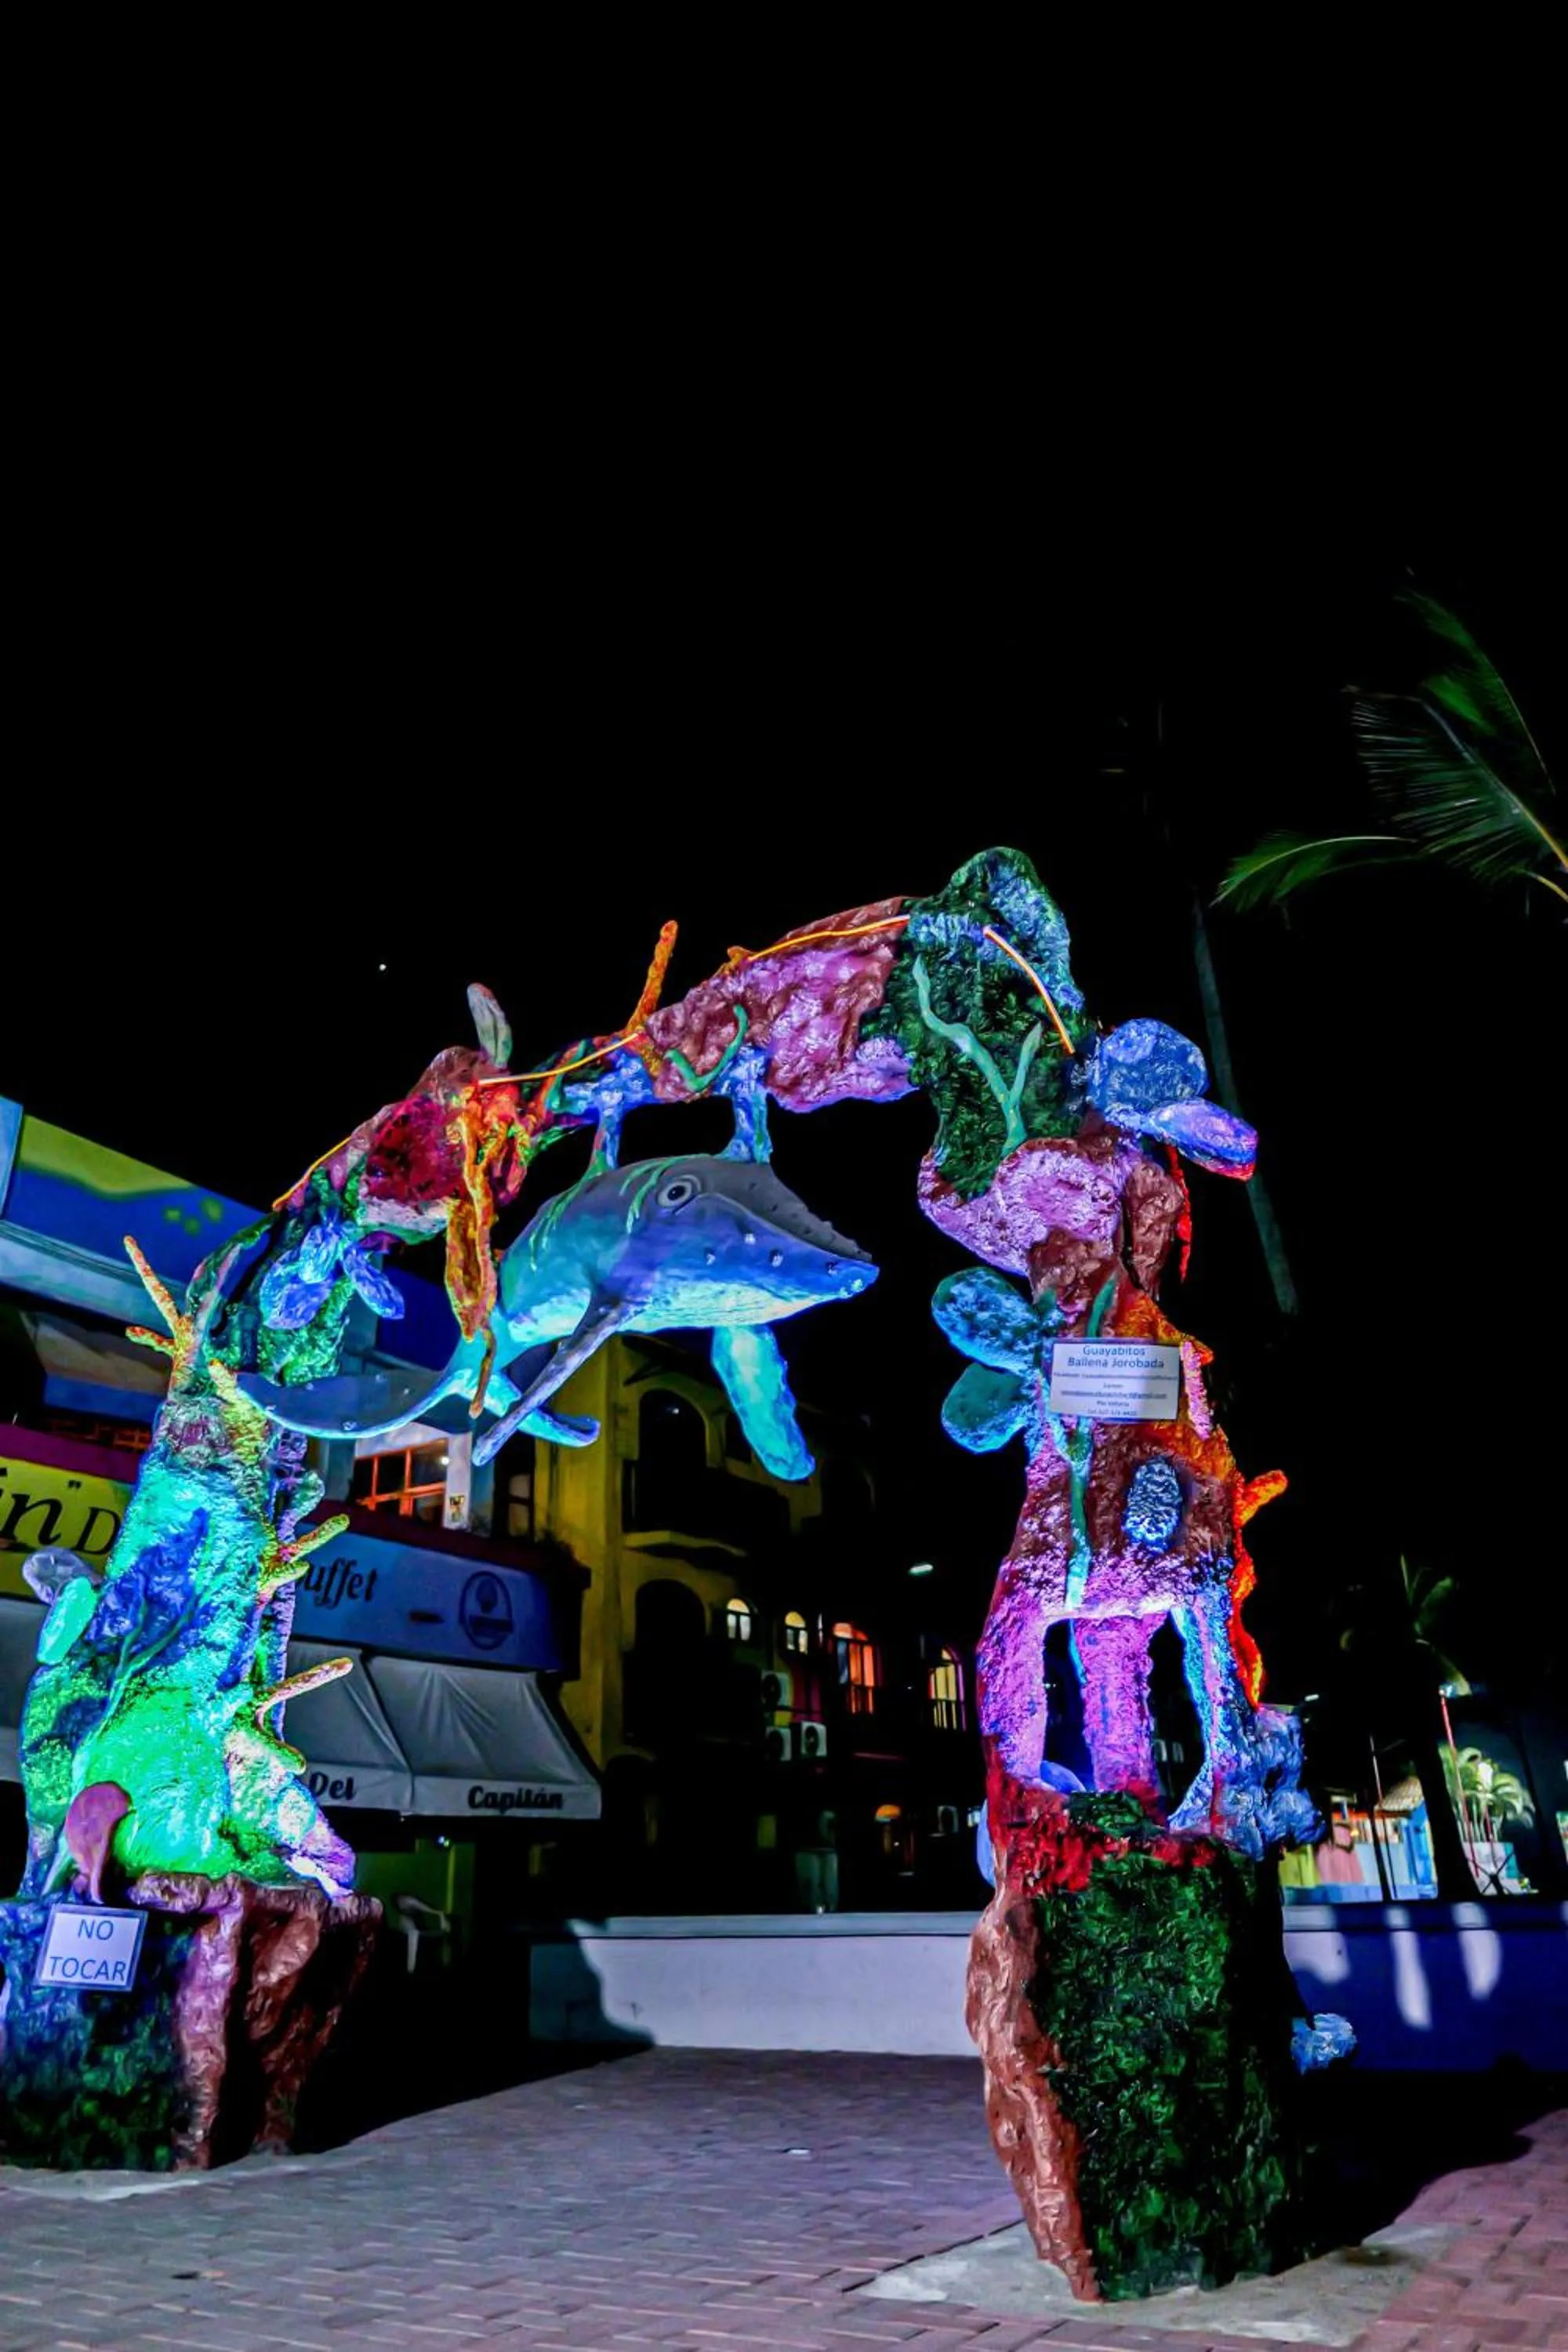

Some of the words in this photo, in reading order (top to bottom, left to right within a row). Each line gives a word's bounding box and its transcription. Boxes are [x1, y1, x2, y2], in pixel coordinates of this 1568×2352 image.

[1083, 1345, 1145, 1356] Guayabitos
[1112, 1358, 1164, 1369] Jorobada
[296, 1556, 377, 1610] uffet
[309, 1771, 356, 1801] Del
[468, 1785, 563, 1814] Capitán
[78, 1918, 114, 1940] NO
[49, 1956, 126, 1982] TOCAR
